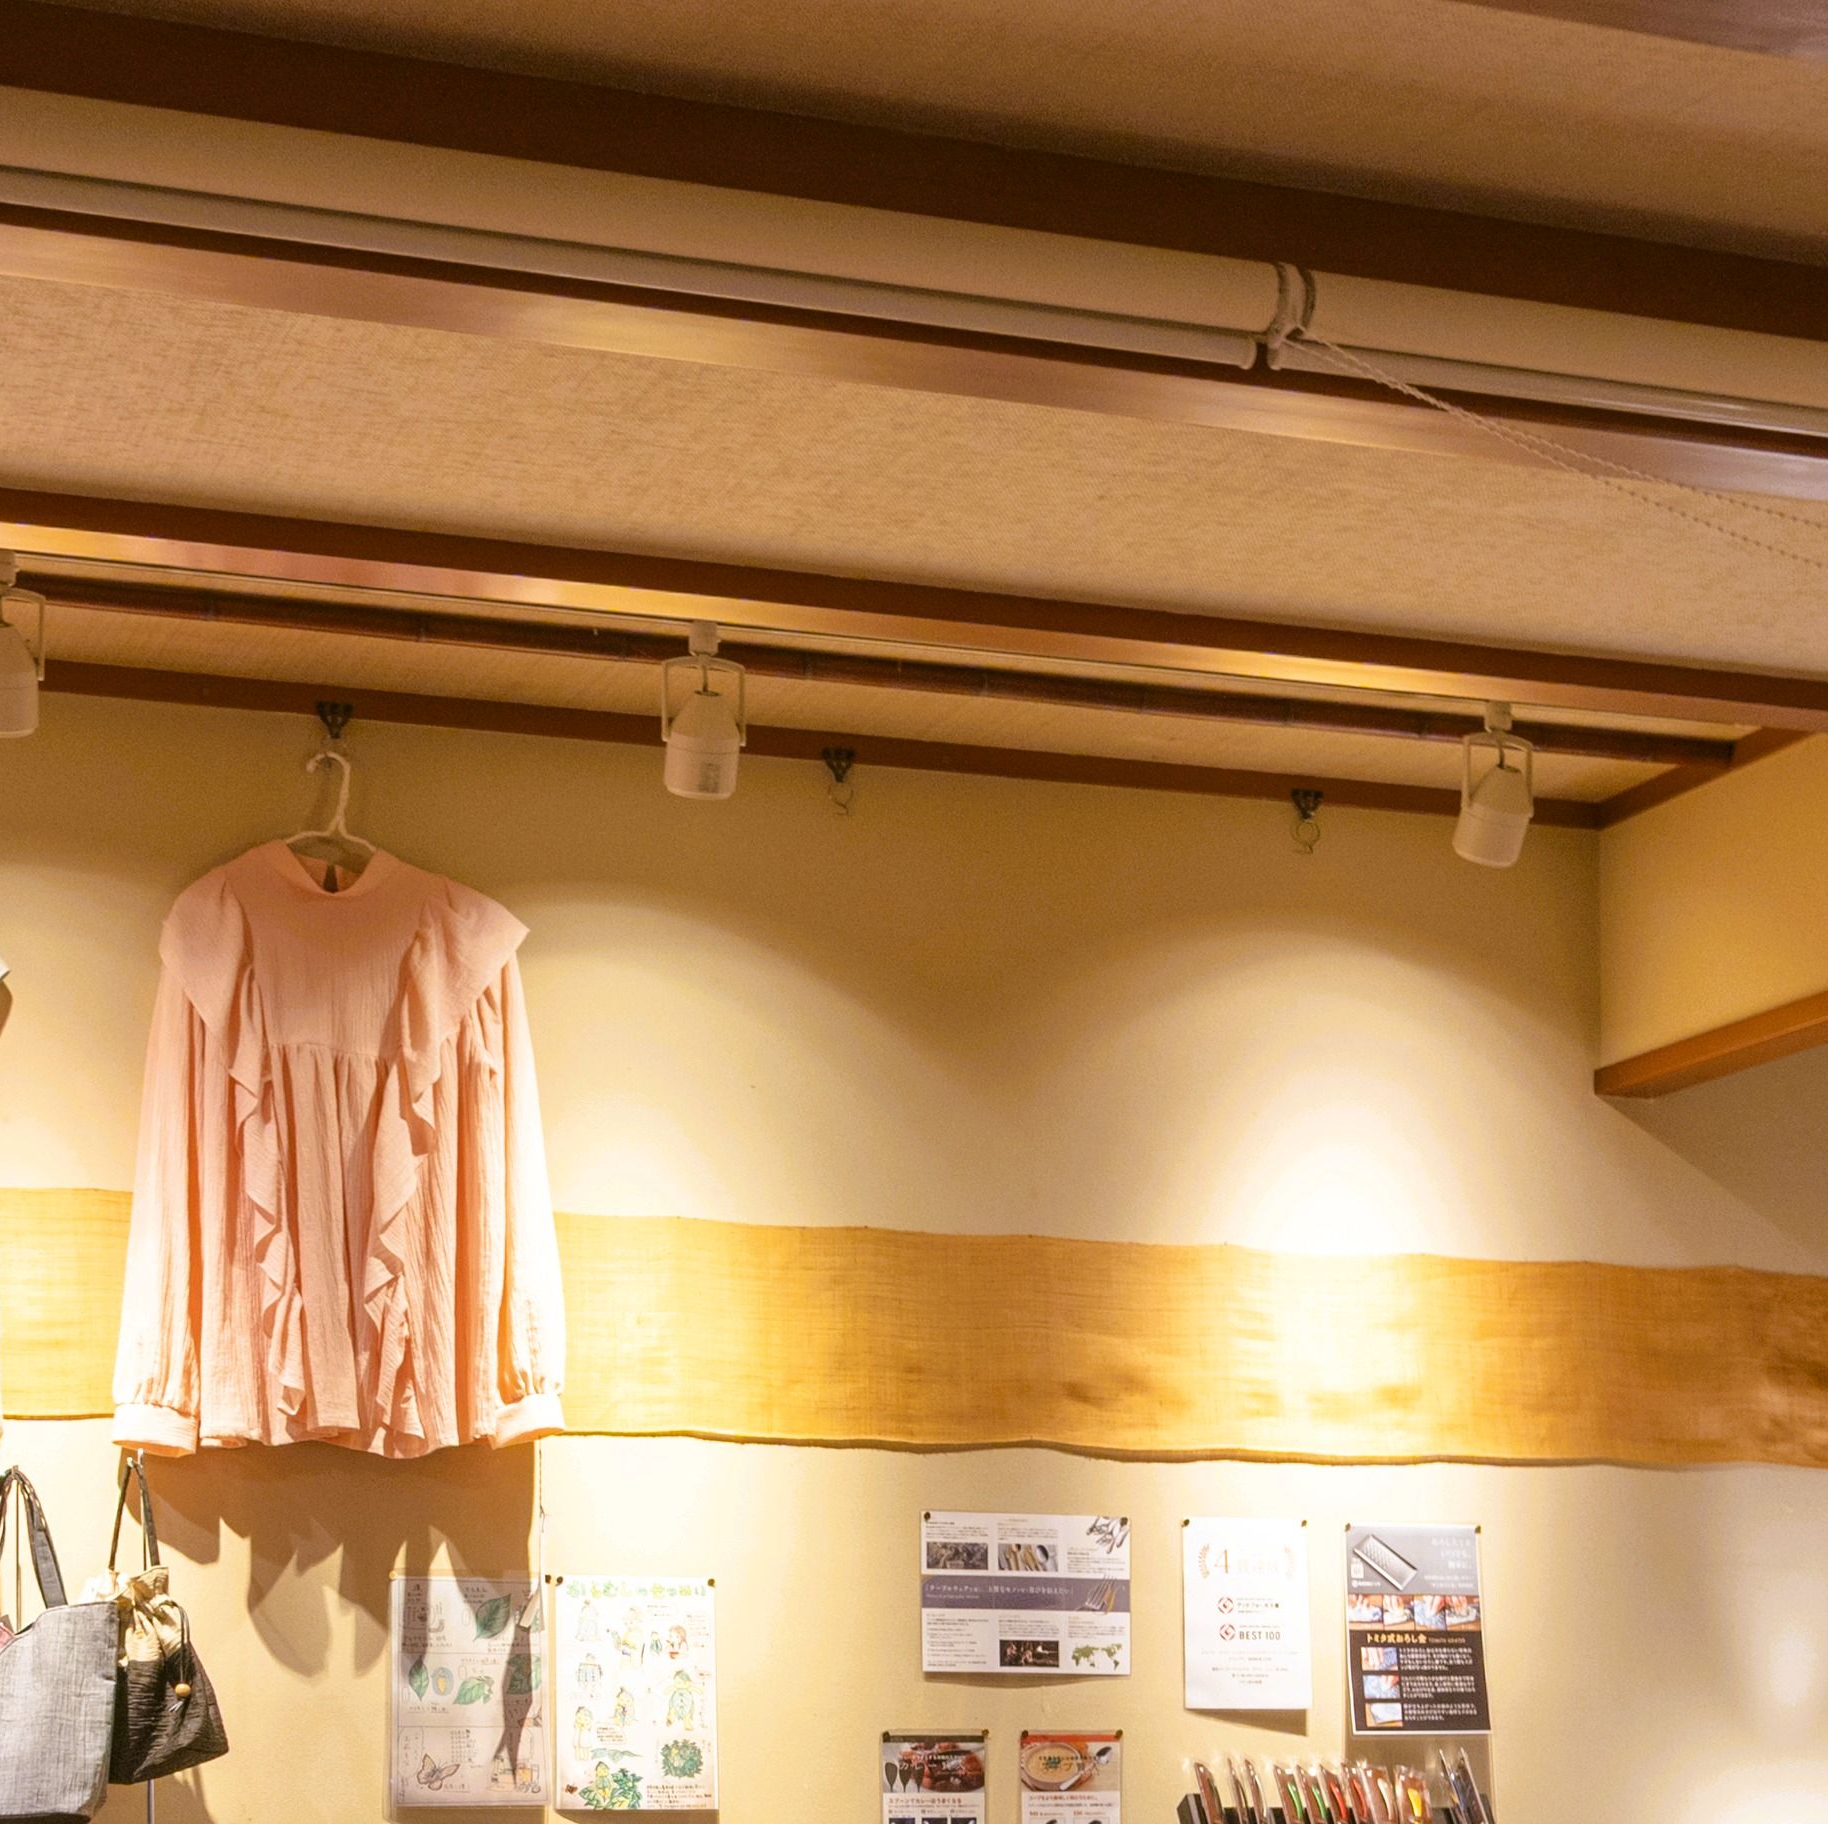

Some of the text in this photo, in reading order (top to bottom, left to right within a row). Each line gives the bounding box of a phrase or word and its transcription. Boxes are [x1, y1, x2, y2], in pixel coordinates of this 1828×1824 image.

[1239, 1631, 1281, 1640] BEST 100
[1366, 1633, 1427, 1644] トミタ式おろし金
